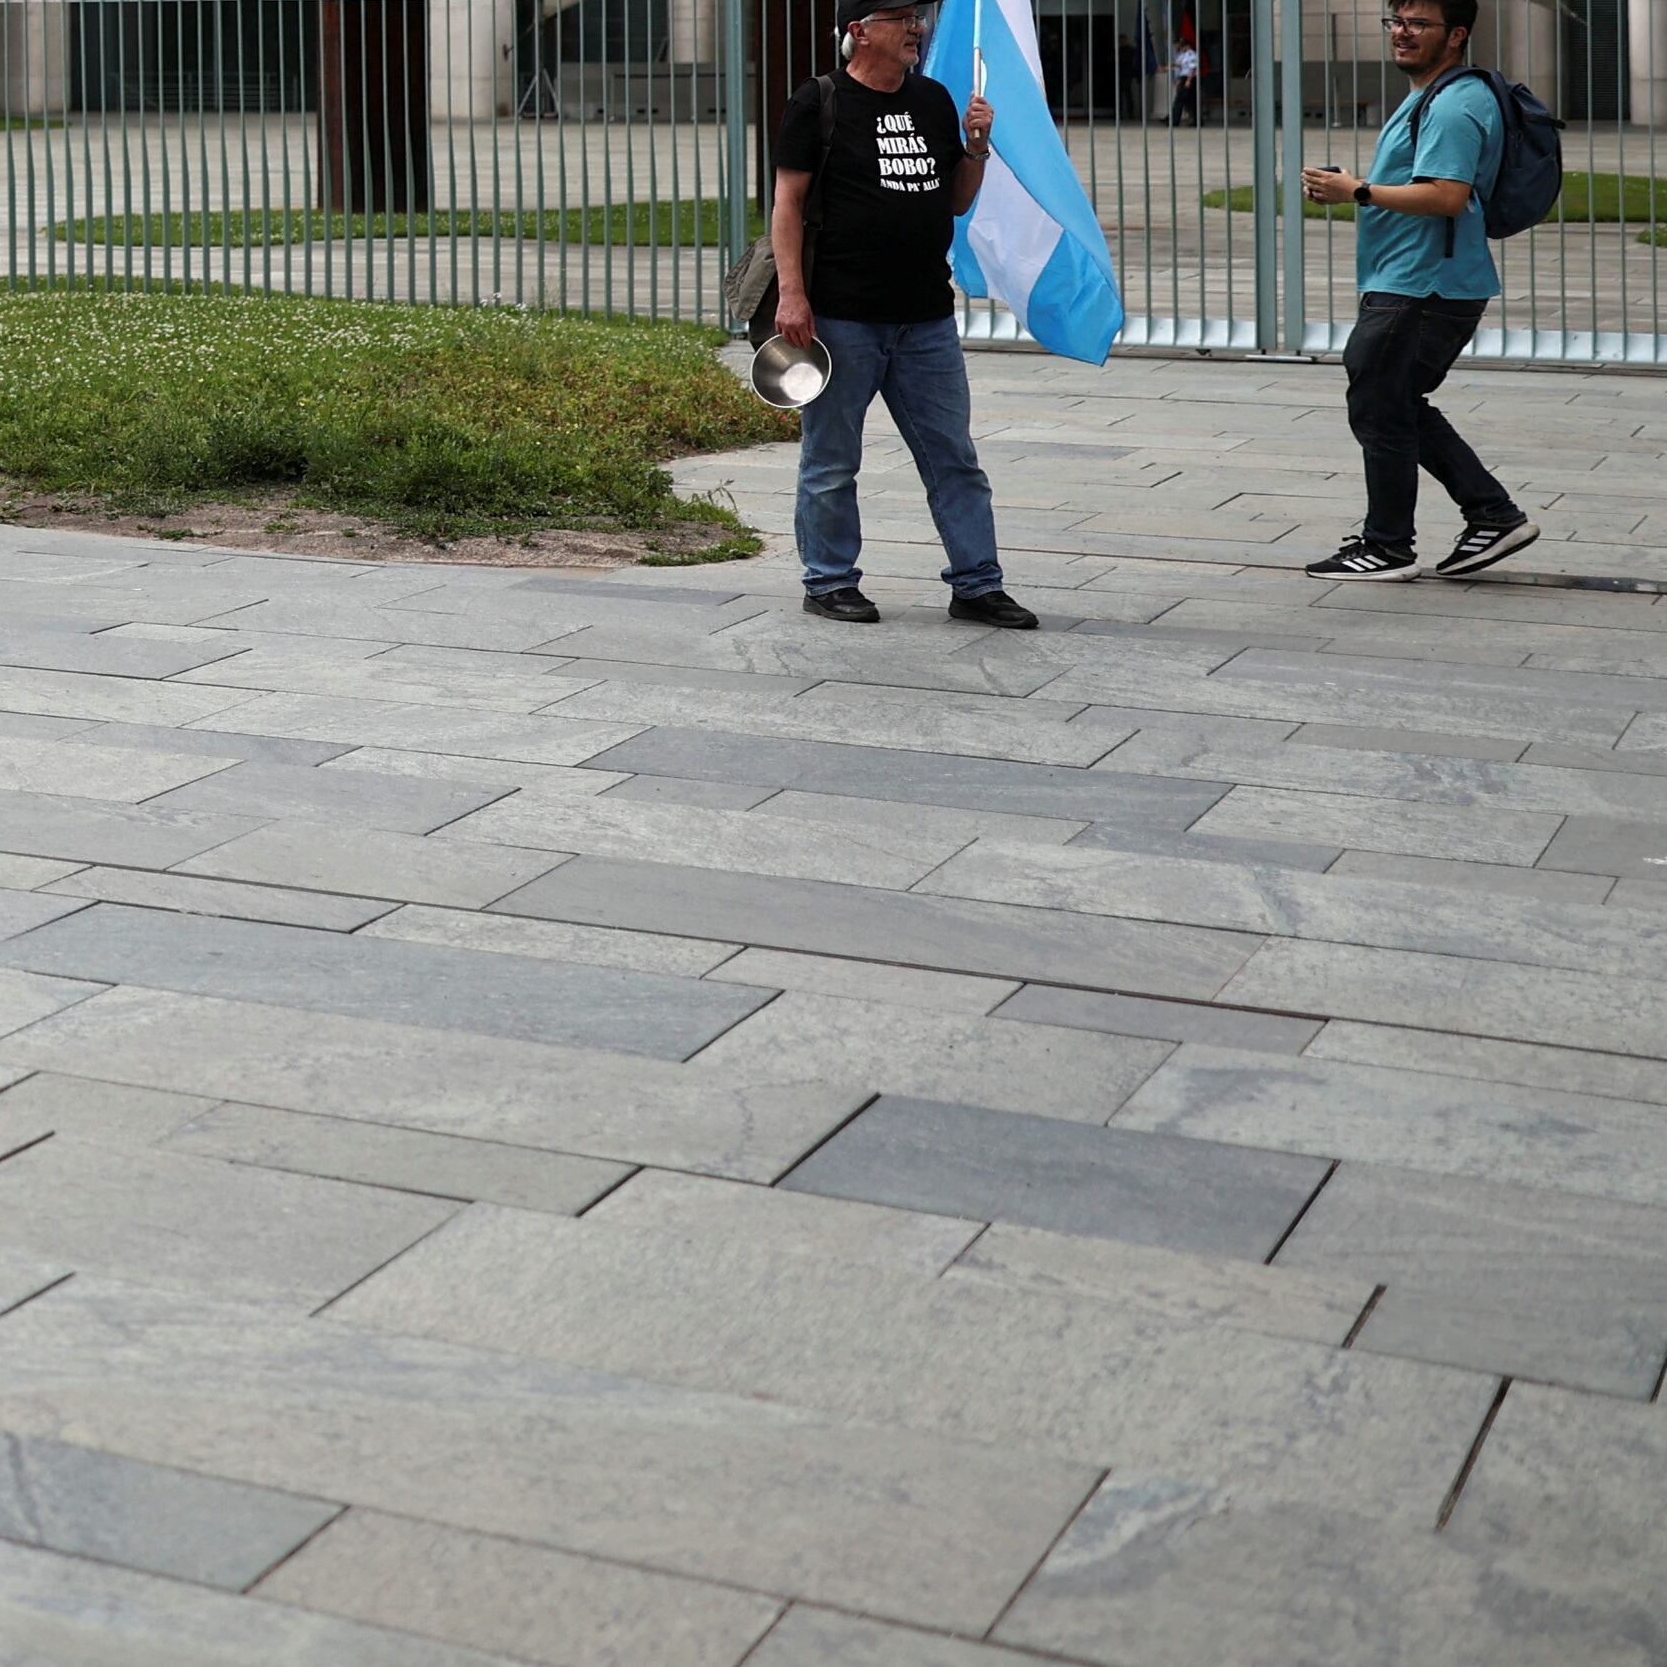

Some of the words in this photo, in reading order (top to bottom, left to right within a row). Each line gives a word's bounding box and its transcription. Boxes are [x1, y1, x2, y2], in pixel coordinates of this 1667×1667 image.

[876, 111, 916, 134] ¿QUÉ
[875, 132, 928, 155] MIRÁS
[877, 157, 936, 176] BOBO?
